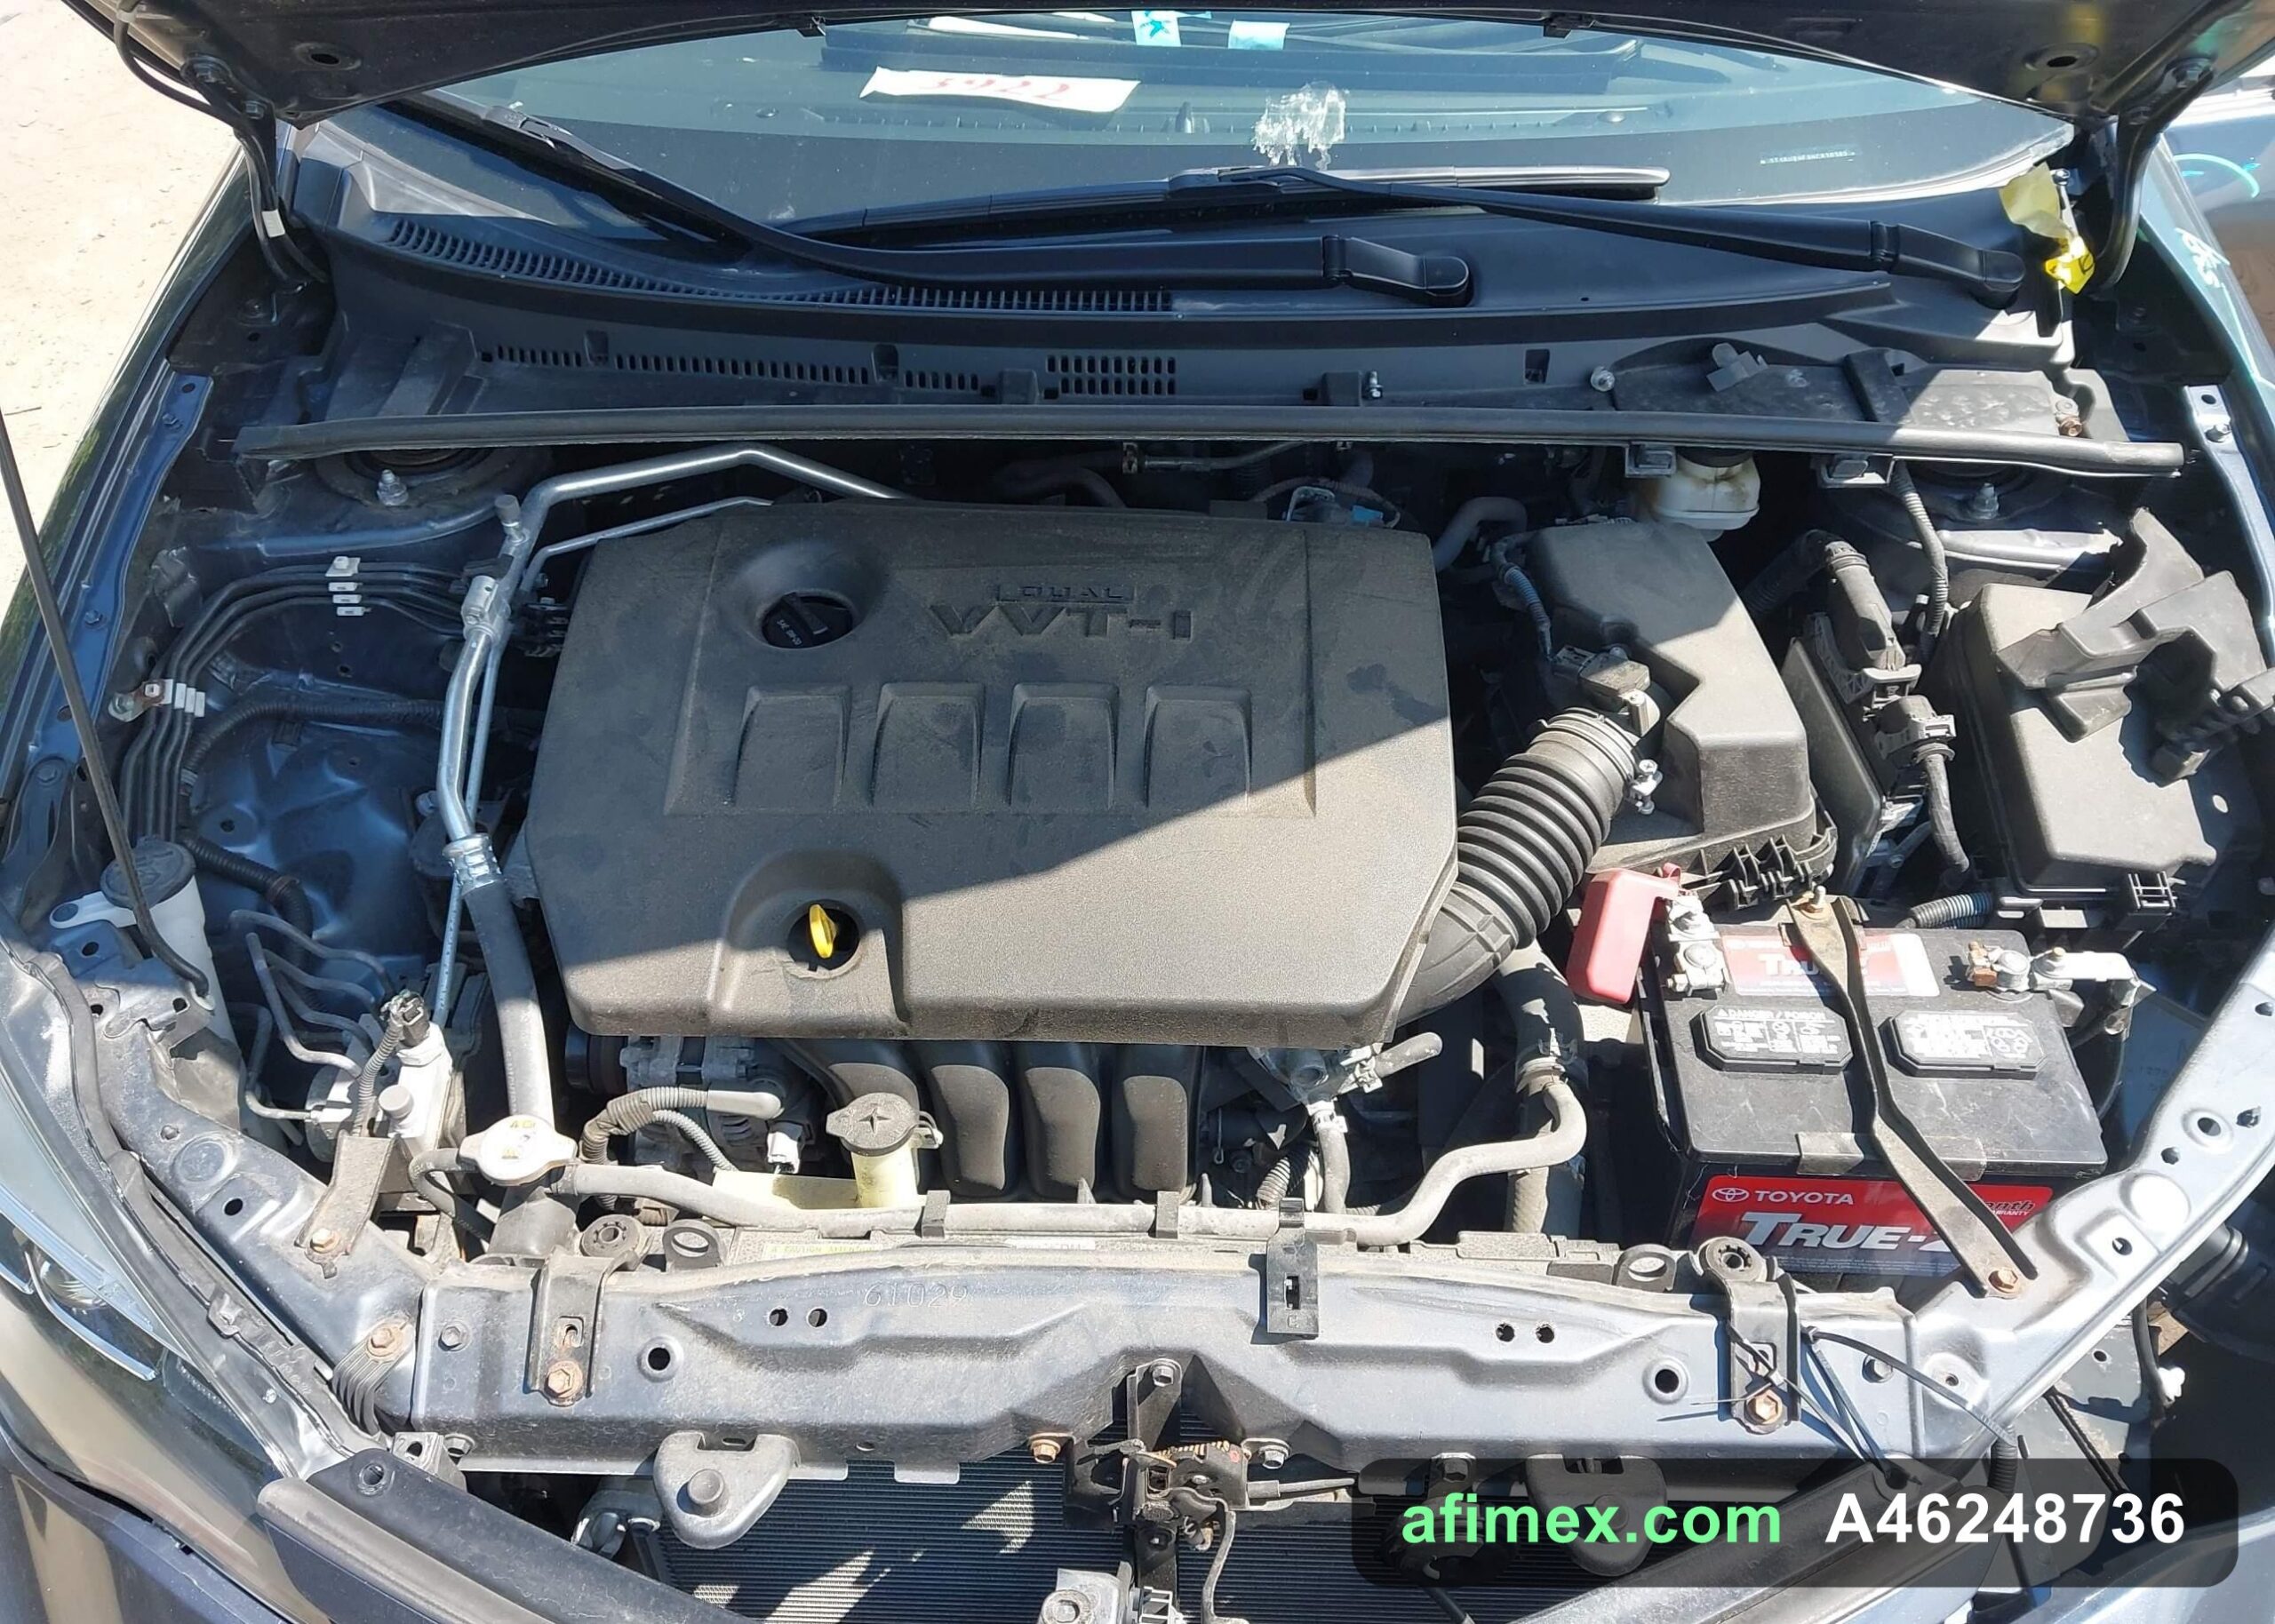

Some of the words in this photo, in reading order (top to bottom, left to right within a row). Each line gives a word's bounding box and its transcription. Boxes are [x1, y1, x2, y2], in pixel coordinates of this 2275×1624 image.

[1022, 586, 1125, 599] DUAL
[1758, 953, 1821, 976] TRU
[1755, 1190, 1854, 1205] TOYOTA
[1985, 1199, 2036, 1211] onth
[863, 1281, 968, 1307] 61029
